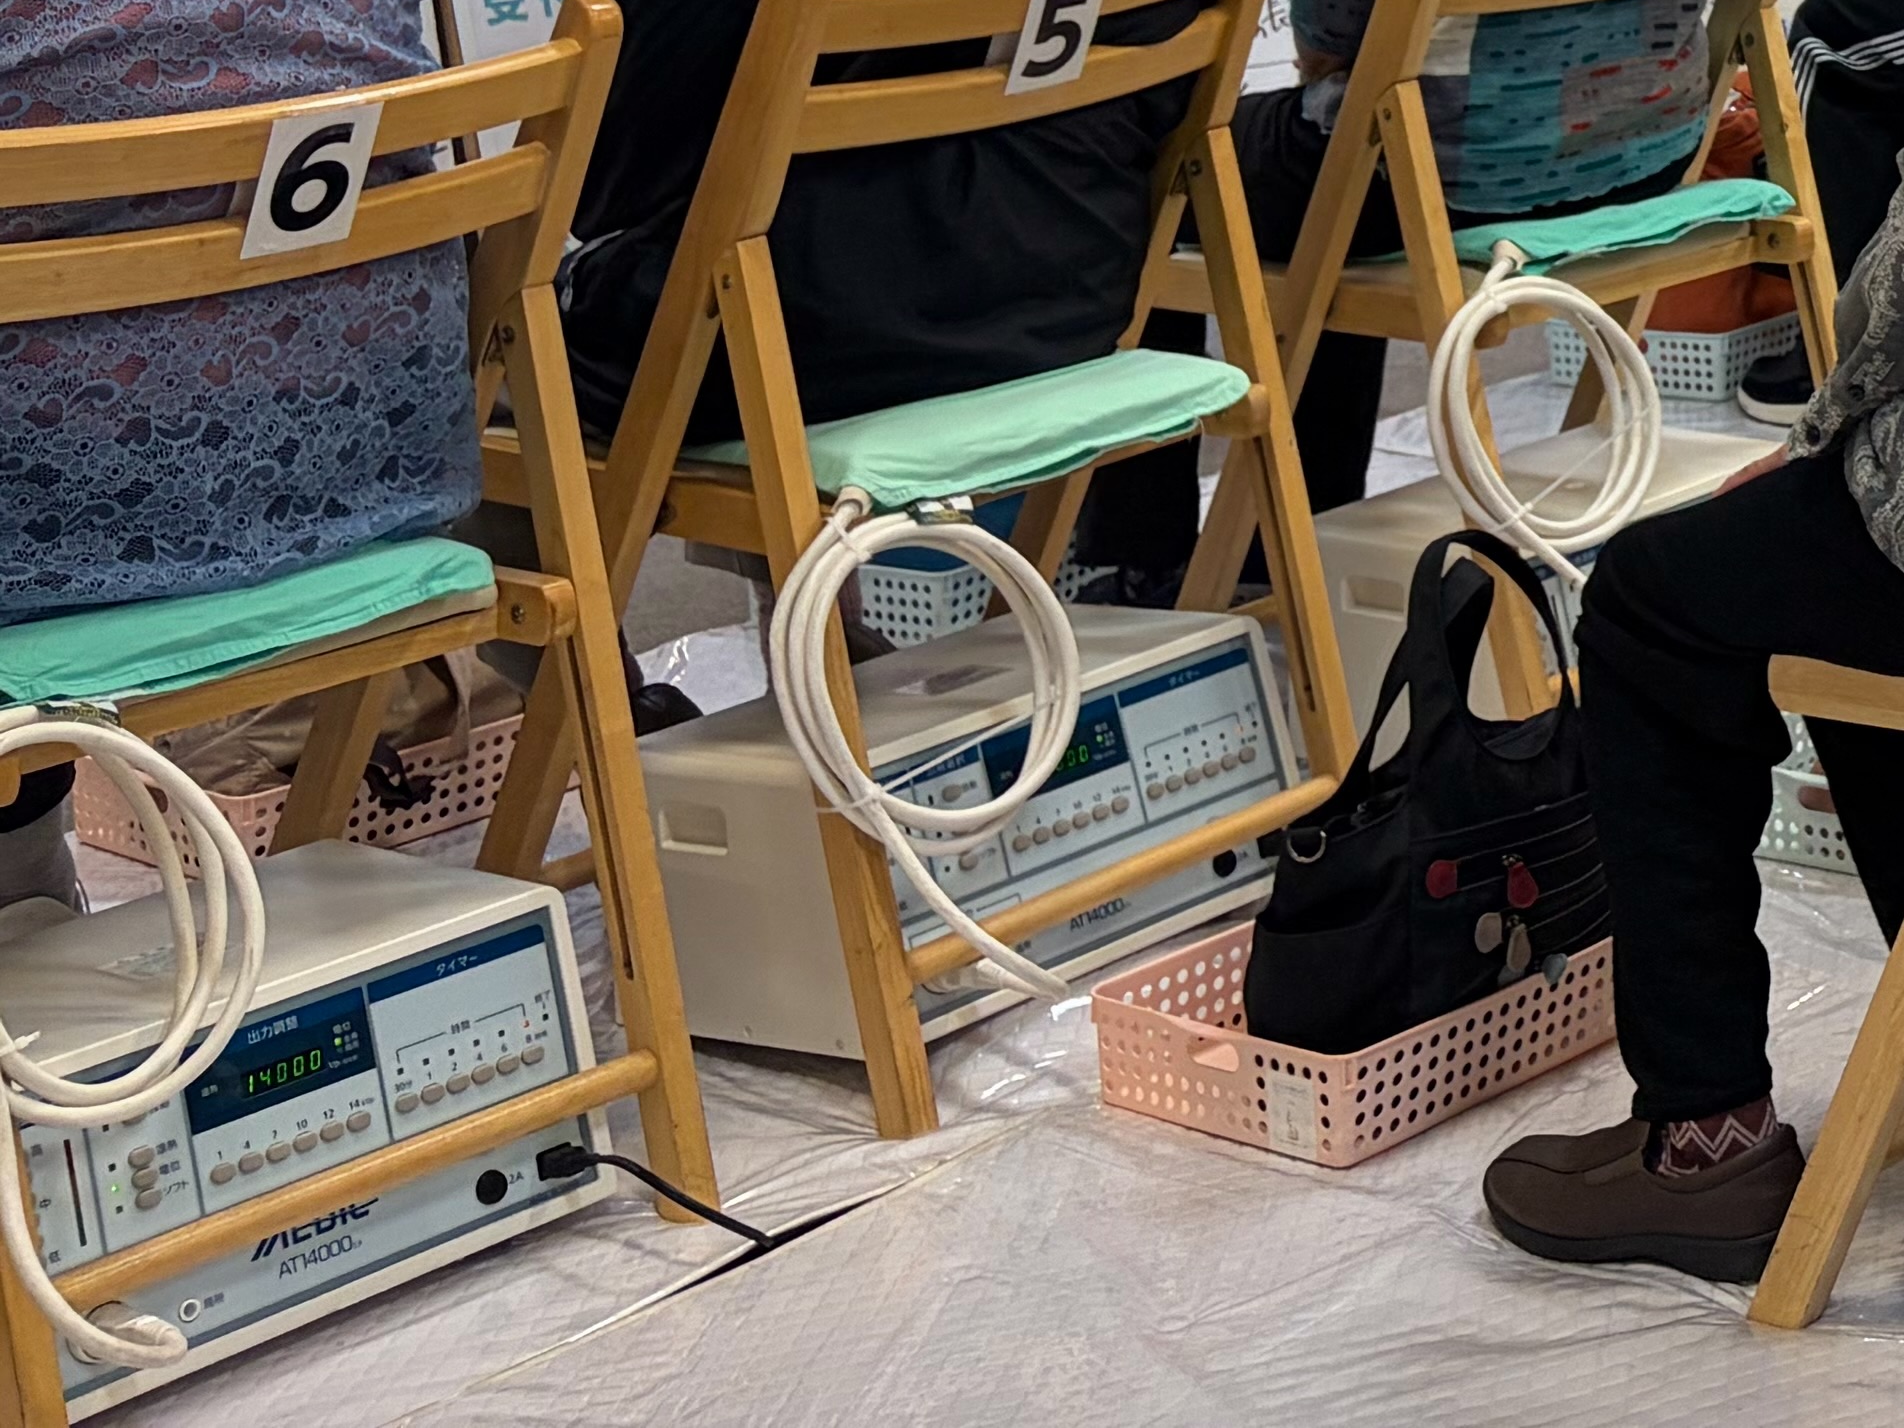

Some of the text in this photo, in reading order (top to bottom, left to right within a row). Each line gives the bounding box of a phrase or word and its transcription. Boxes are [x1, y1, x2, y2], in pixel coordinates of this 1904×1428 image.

[269, 122, 357, 232] 6
[248, 1049, 321, 1093] 14000
[296, 1119, 308, 1130] 10
[323, 1109, 335, 1119] 12
[278, 1235, 353, 1280] AT14000
